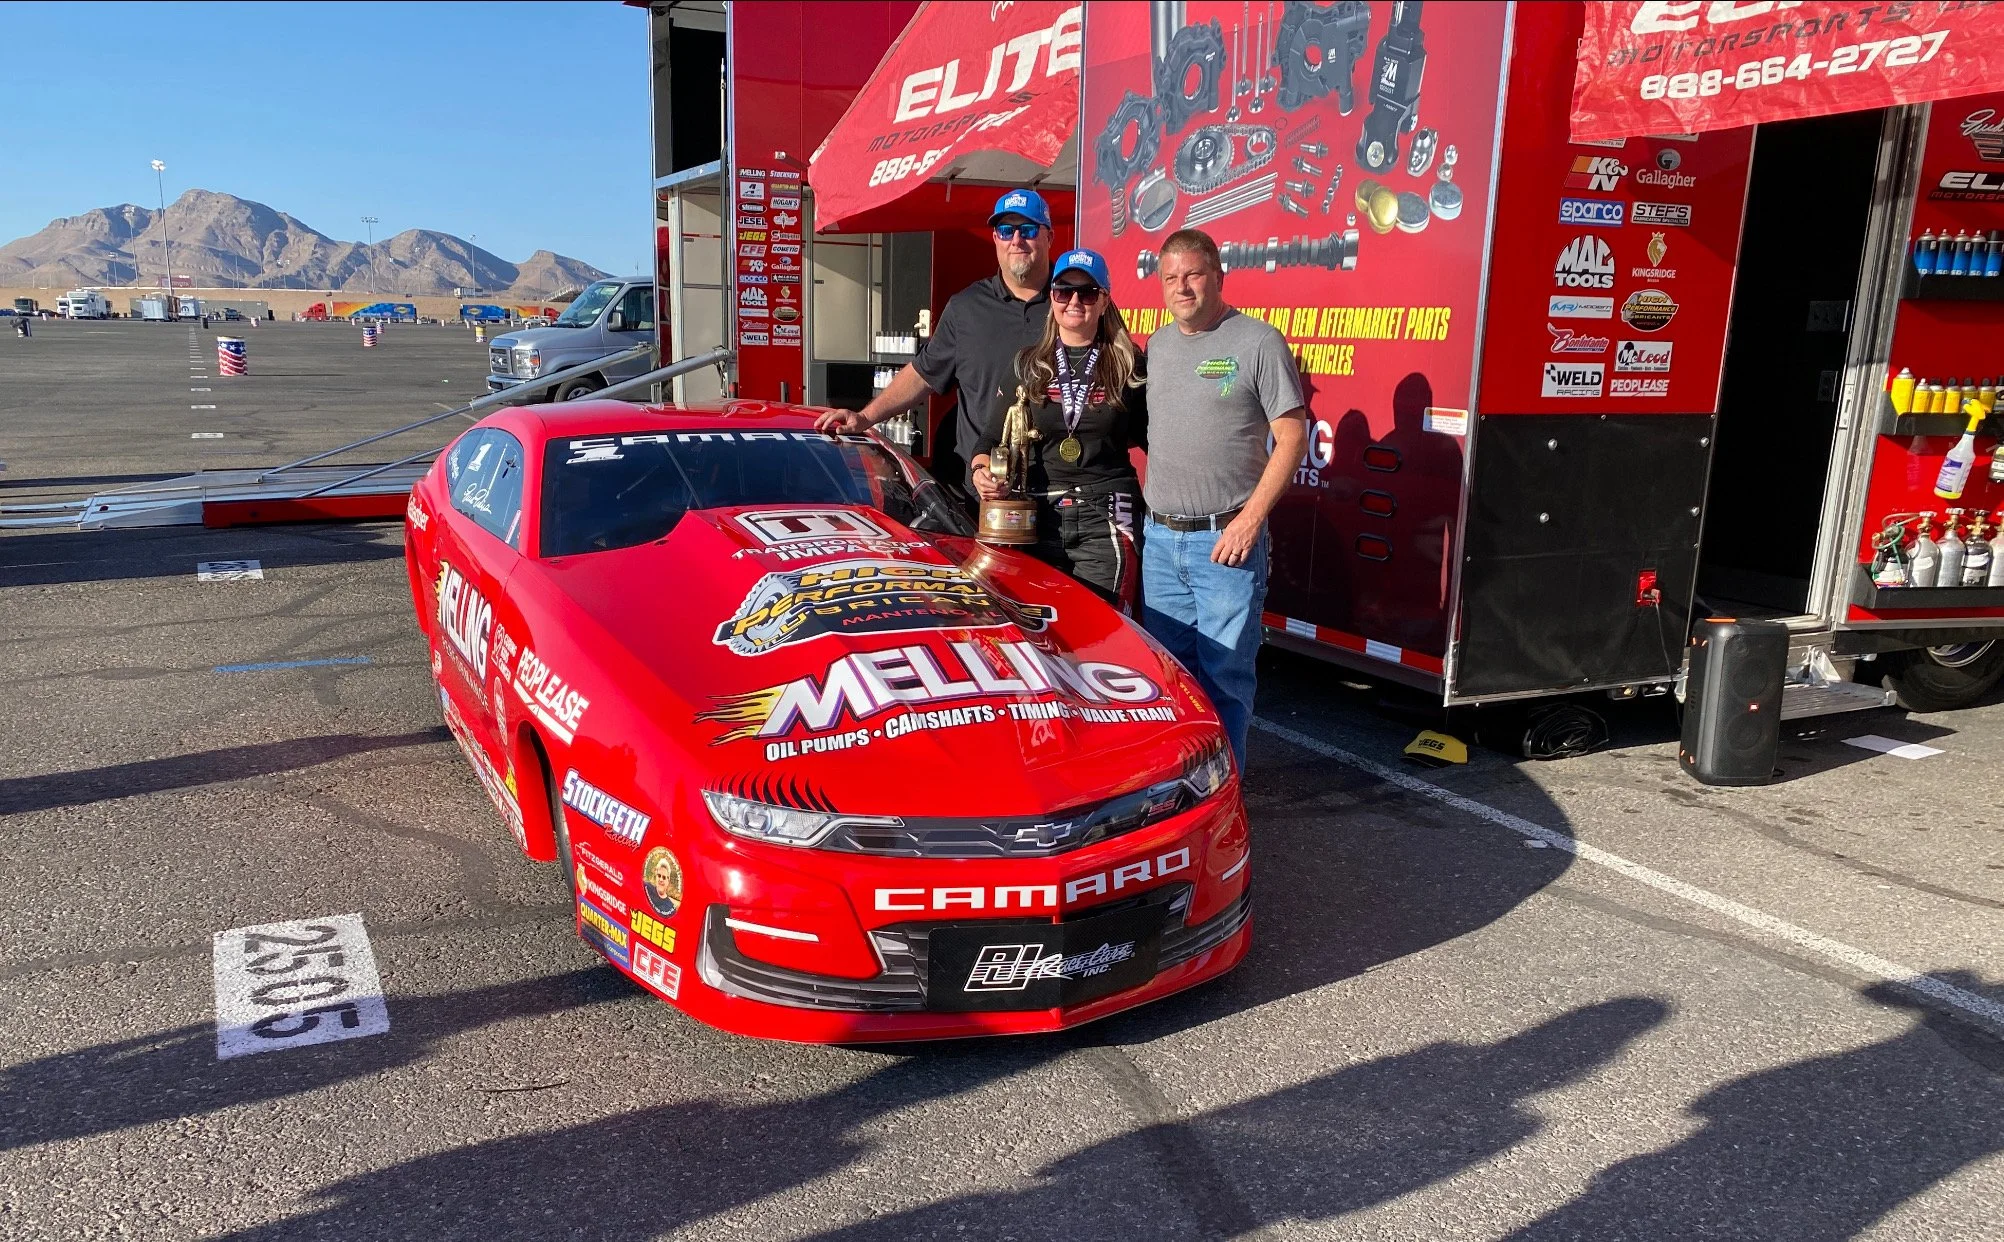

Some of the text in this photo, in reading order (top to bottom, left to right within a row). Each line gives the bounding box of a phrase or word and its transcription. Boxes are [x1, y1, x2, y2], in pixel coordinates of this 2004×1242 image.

[1607, 4, 1912, 68] MOTORSPORTS
[893, 5, 1082, 124] ELITE
[1640, 30, 1951, 100] 888-664-2727
[1636, 169, 1696, 189] Gallagher
[739, 216, 766, 226] JESEL
[1562, 201, 1623, 222] sparco
[1635, 204, 1689, 218] STEF'S
[741, 244, 766, 254] CFE
[1556, 235, 1615, 273] MAC
[771, 263, 800, 271] Gallagher
[1555, 273, 1613, 289] TOOLS
[1632, 268, 1676, 278] KINGSRIDGE
[1624, 303, 1677, 312] PERFORMANCE
[1638, 295, 1668, 303] HIGH
[1138, 308, 1157, 334] FULL
[1291, 308, 1318, 337] OEM
[1318, 308, 1406, 339] AFTERMARKET
[1404, 307, 1452, 340] PARTS
[1056, 348, 1066, 375] NHRA
[1085, 348, 1099, 375] NHRA
[1300, 344, 1355, 375] VEHICLES.
[1557, 371, 1602, 386] WELD
[1610, 379, 1670, 391] PEOPLEASE
[1062, 382, 1073, 414] NHRA
[1074, 384, 1088, 413] NHRA
[776, 544, 911, 562] IMPACT
[440, 565, 493, 682] MELLING
[516, 645, 591, 732] PEOPLEASE
[757, 640, 1163, 739] MELLING
[766, 701, 1178, 762] OIL PUMPS CAMSHAFTS TIMING VALVE TRAIN
[562, 769, 651, 846] STOCKSETH
[603, 822, 641, 853] Racing
[581, 847, 624, 881] FITZGERALD
[874, 846, 1190, 911] CAMARO
[587, 879, 627, 916] KINGSRIDGE
[580, 902, 628, 949] QUARTER-MAX
[631, 910, 677, 954] JEGS
[243, 924, 361, 1040] 2505
[635, 947, 679, 991] CFE
[1082, 966, 1112, 978] INC.
